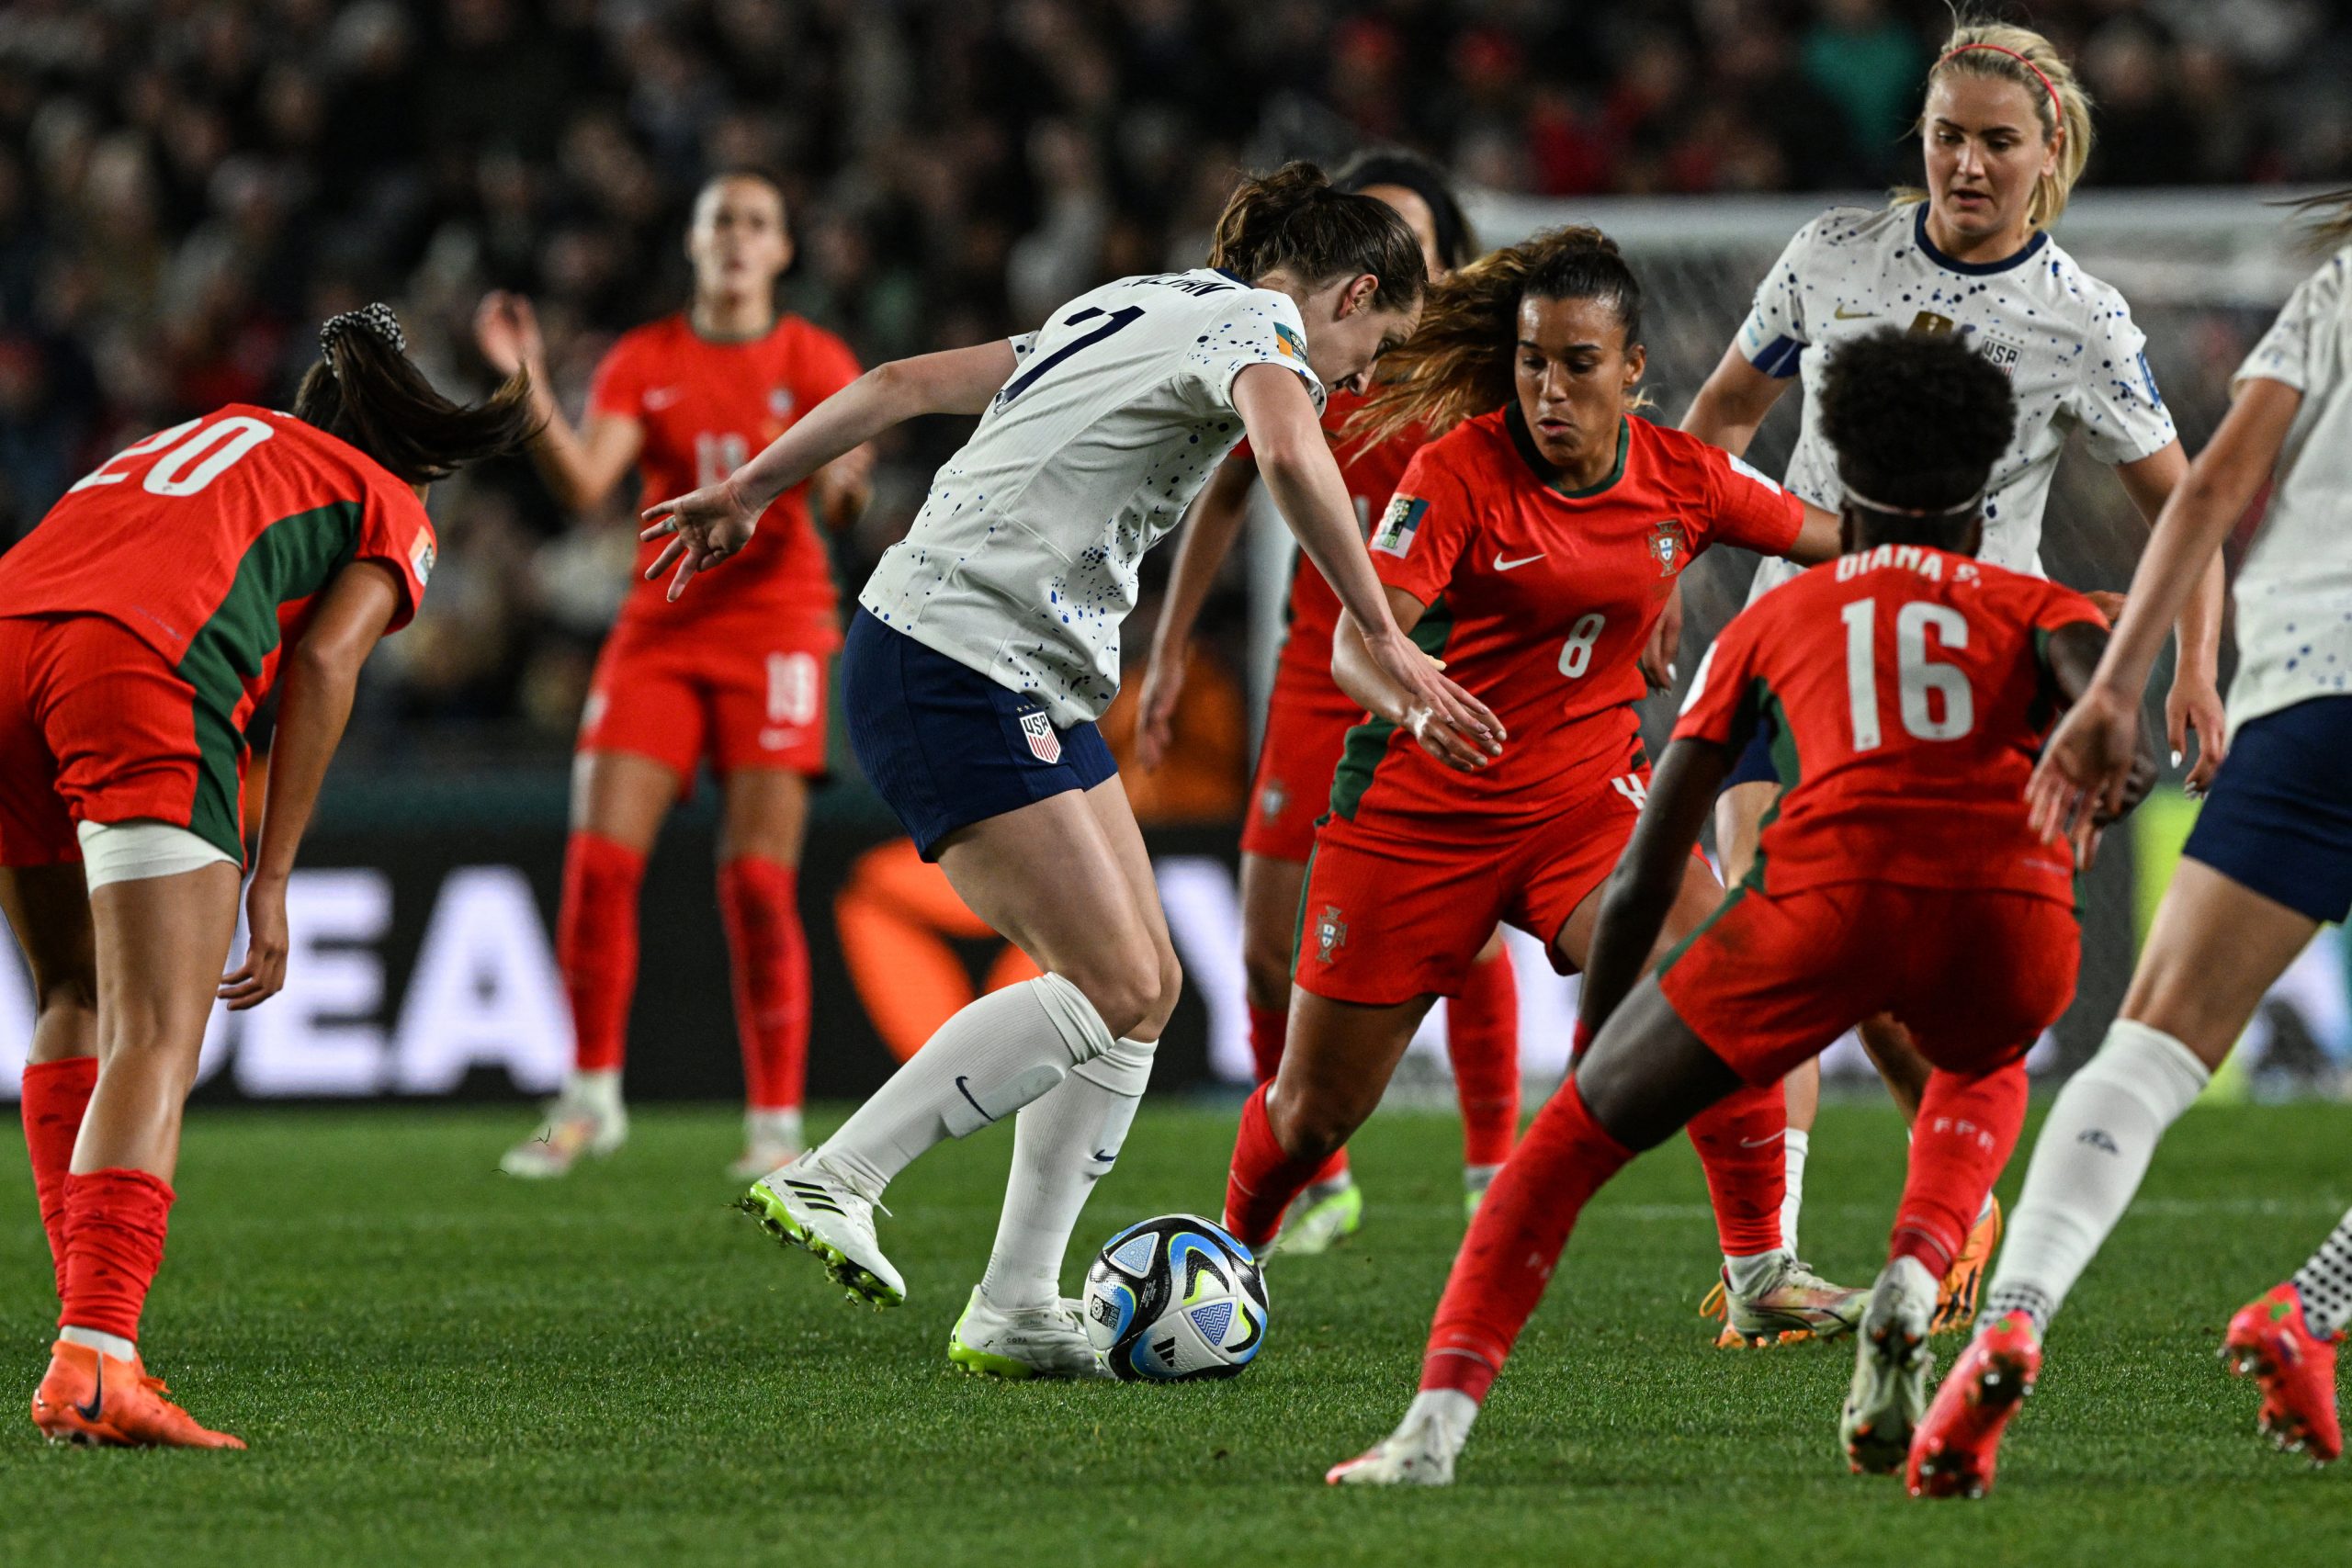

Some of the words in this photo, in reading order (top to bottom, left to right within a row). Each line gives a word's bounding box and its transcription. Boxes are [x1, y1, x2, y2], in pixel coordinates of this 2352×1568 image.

[1984, 340, 2018, 364] USA
[67, 416, 274, 496] 20
[1836, 544, 1941, 582] DIANA
[1558, 614, 1606, 679] 8
[1841, 597, 1974, 752] 16
[1023, 715, 1048, 736] USA
